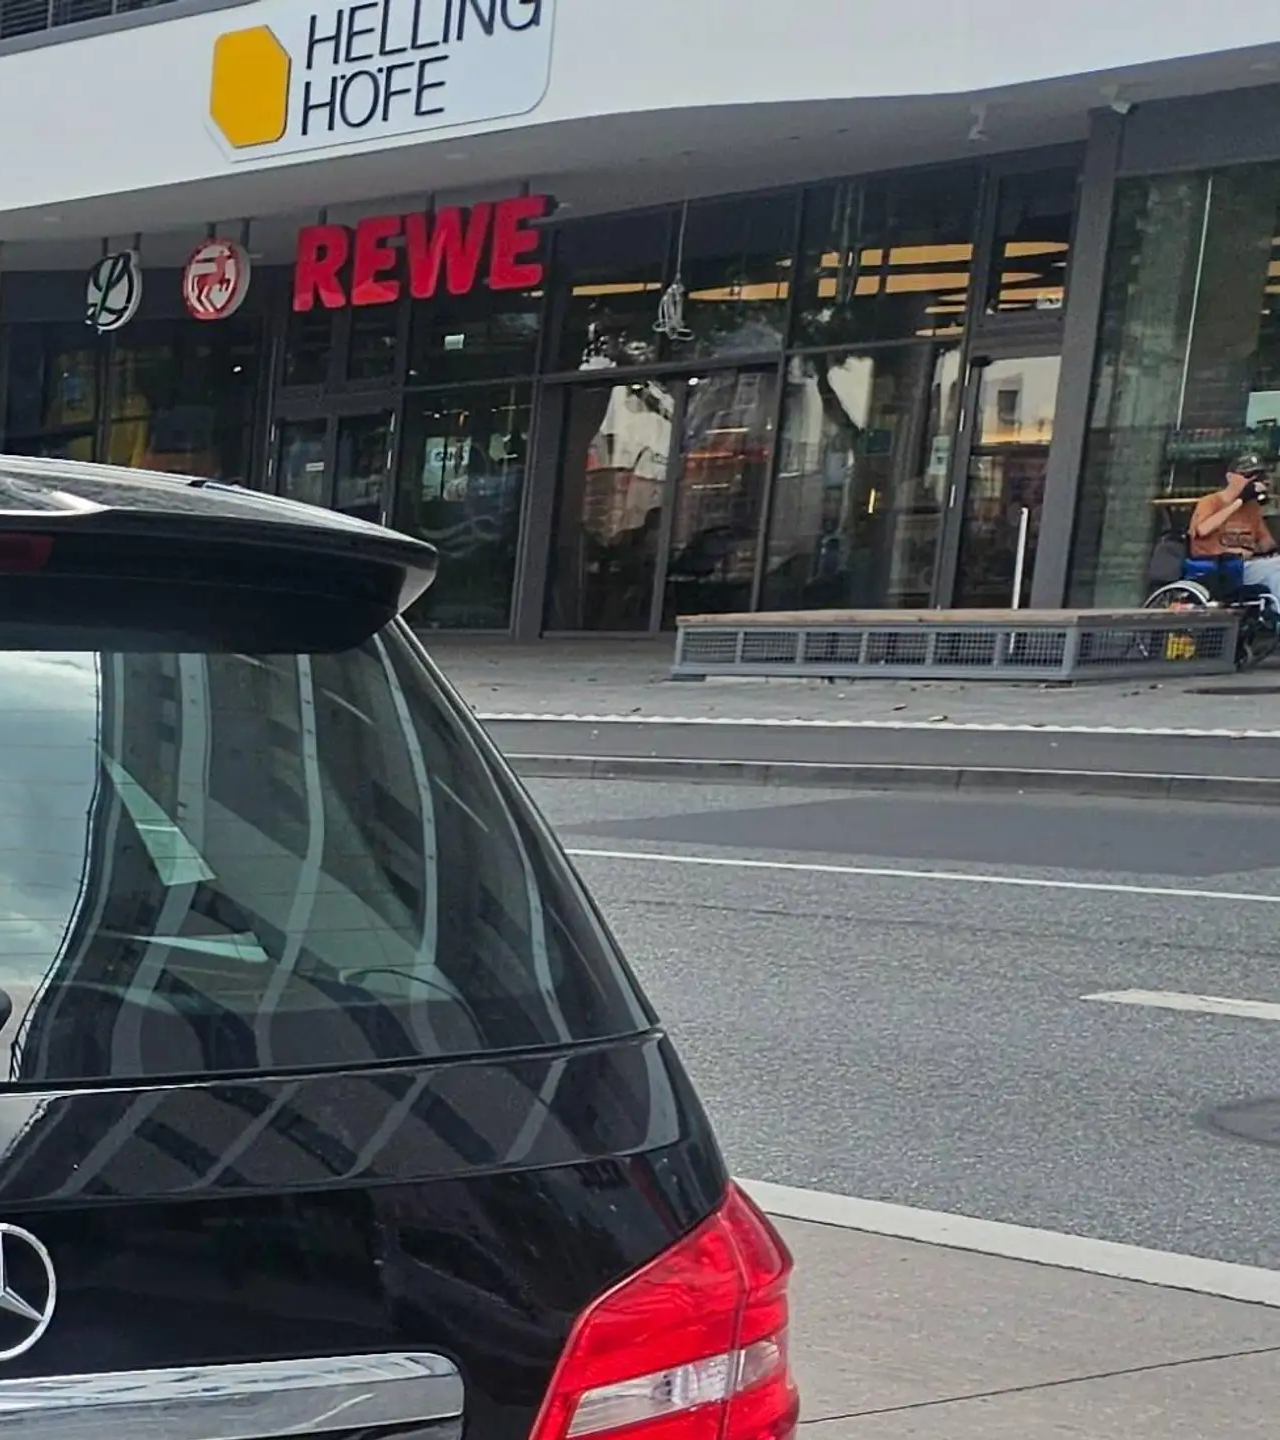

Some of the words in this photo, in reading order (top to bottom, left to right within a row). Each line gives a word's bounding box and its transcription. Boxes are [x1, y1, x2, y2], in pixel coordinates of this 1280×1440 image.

[306, 0, 541, 70] HELLING
[301, 55, 450, 136] HÖFE
[293, 195, 548, 312] REWE
